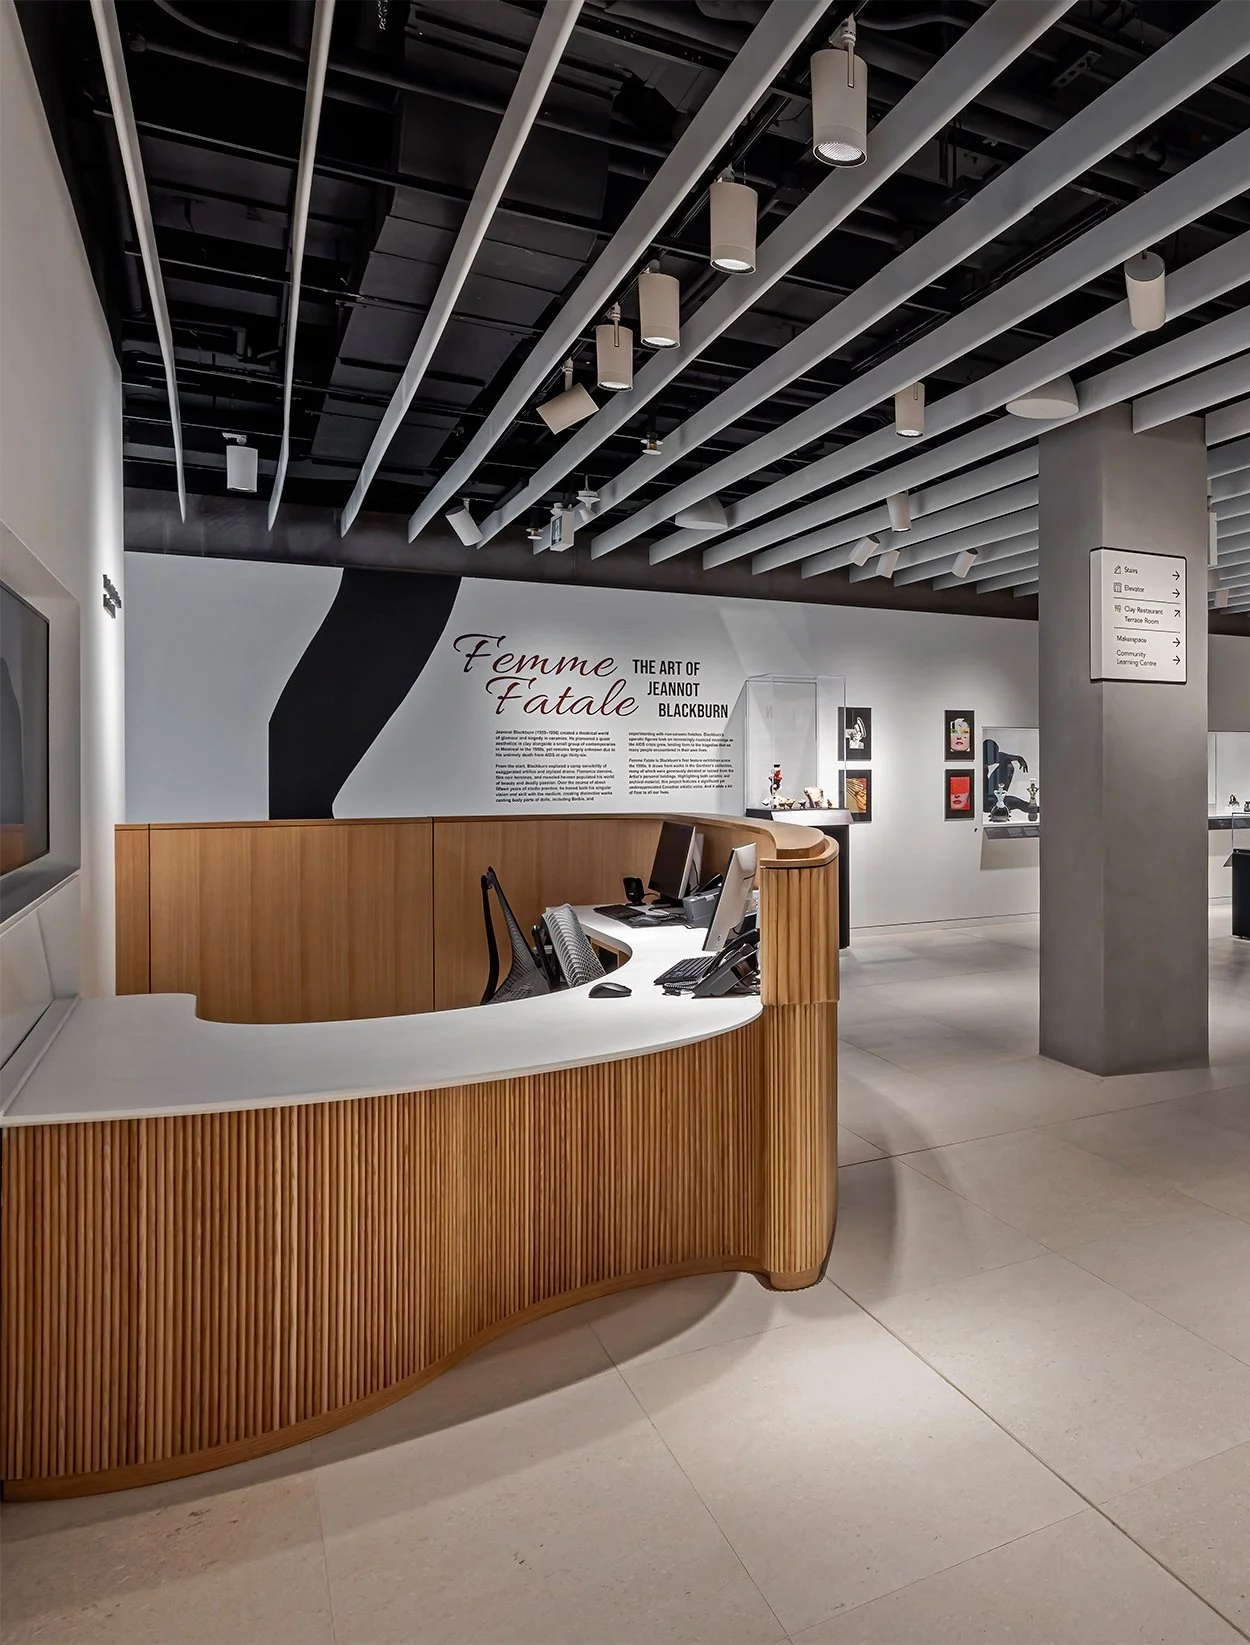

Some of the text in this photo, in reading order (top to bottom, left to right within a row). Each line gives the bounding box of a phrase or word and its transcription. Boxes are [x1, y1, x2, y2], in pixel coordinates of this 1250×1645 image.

[1124, 606, 1135, 614] Clay
[1125, 616, 1143, 624] Terrace
[1117, 636, 1147, 644] Makerspace
[453, 633, 618, 677] Femme
[1117, 650, 1146, 658] Community
[633, 659, 700, 676] THE ART OF
[485, 676, 639, 716] Fatale
[647, 681, 700, 697] JEANNOT
[659, 703, 728, 718] BLACKBURN
